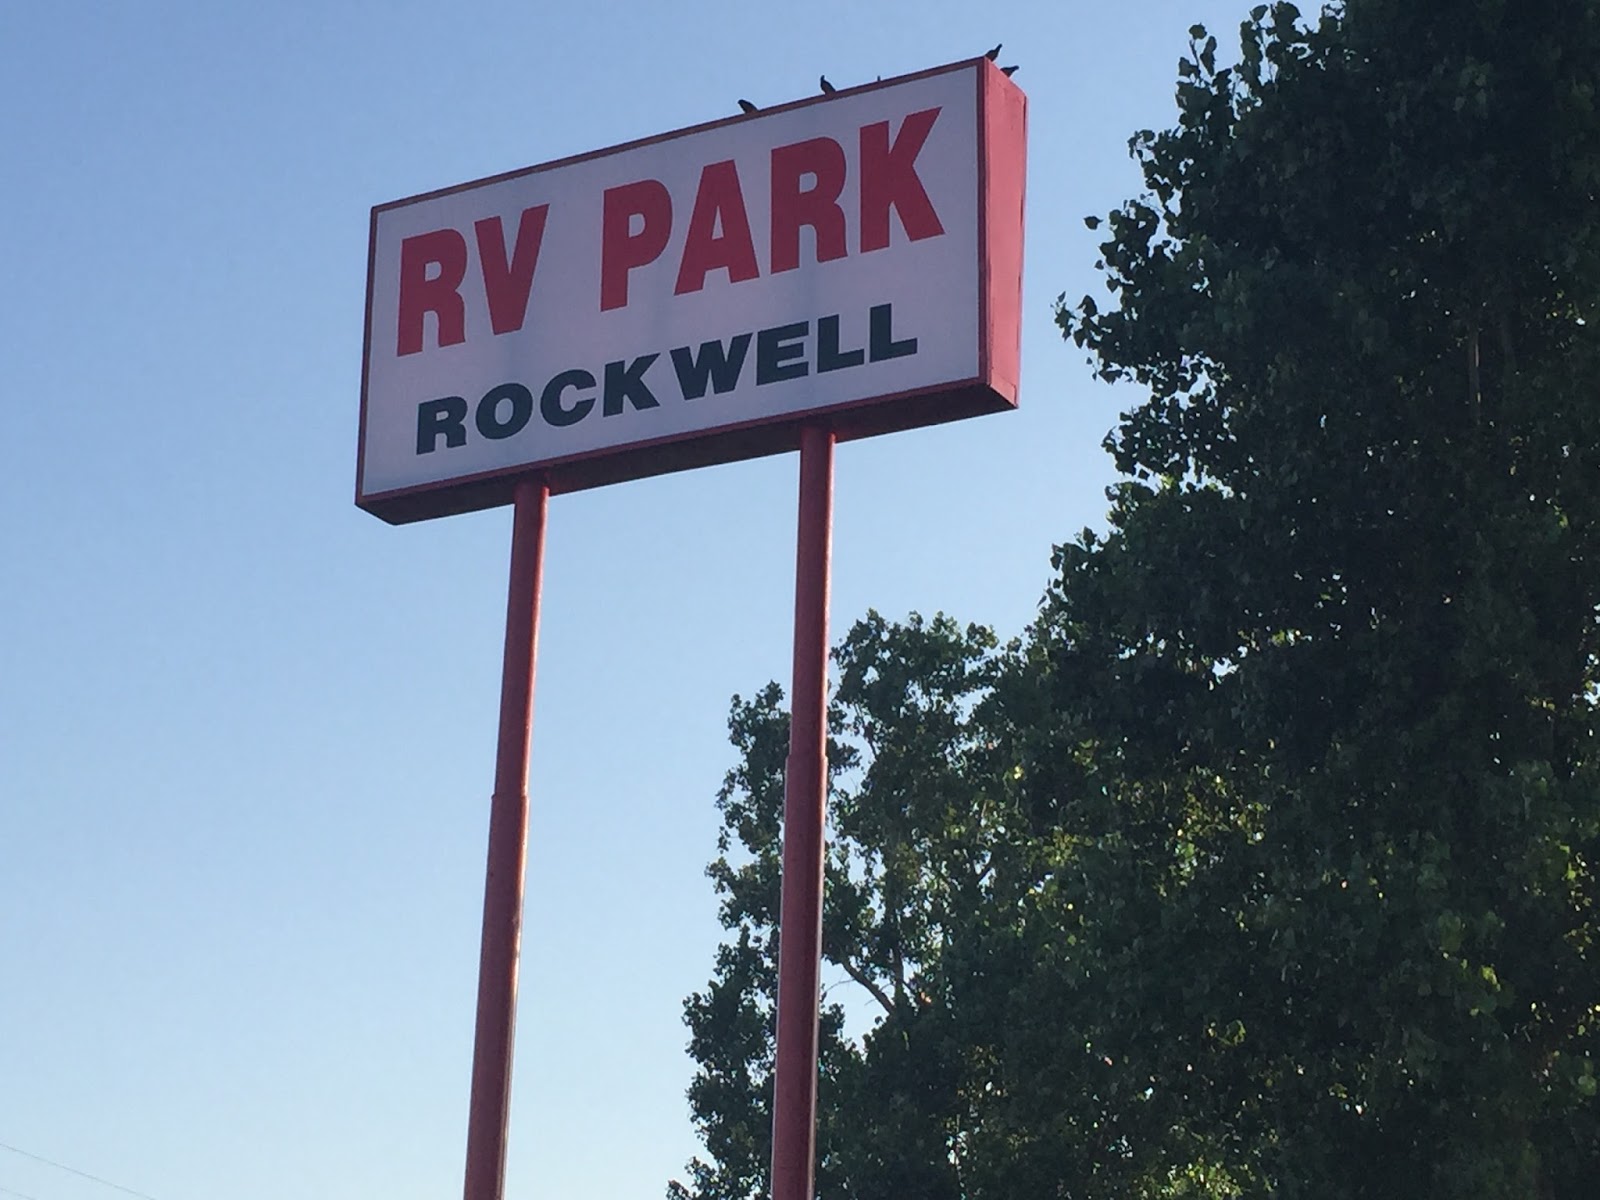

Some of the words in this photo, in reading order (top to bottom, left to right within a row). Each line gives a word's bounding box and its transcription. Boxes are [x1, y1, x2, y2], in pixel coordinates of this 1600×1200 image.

[398, 204, 550, 356] RV
[600, 107, 945, 311] PARK
[417, 303, 918, 454] ROCKWELL
